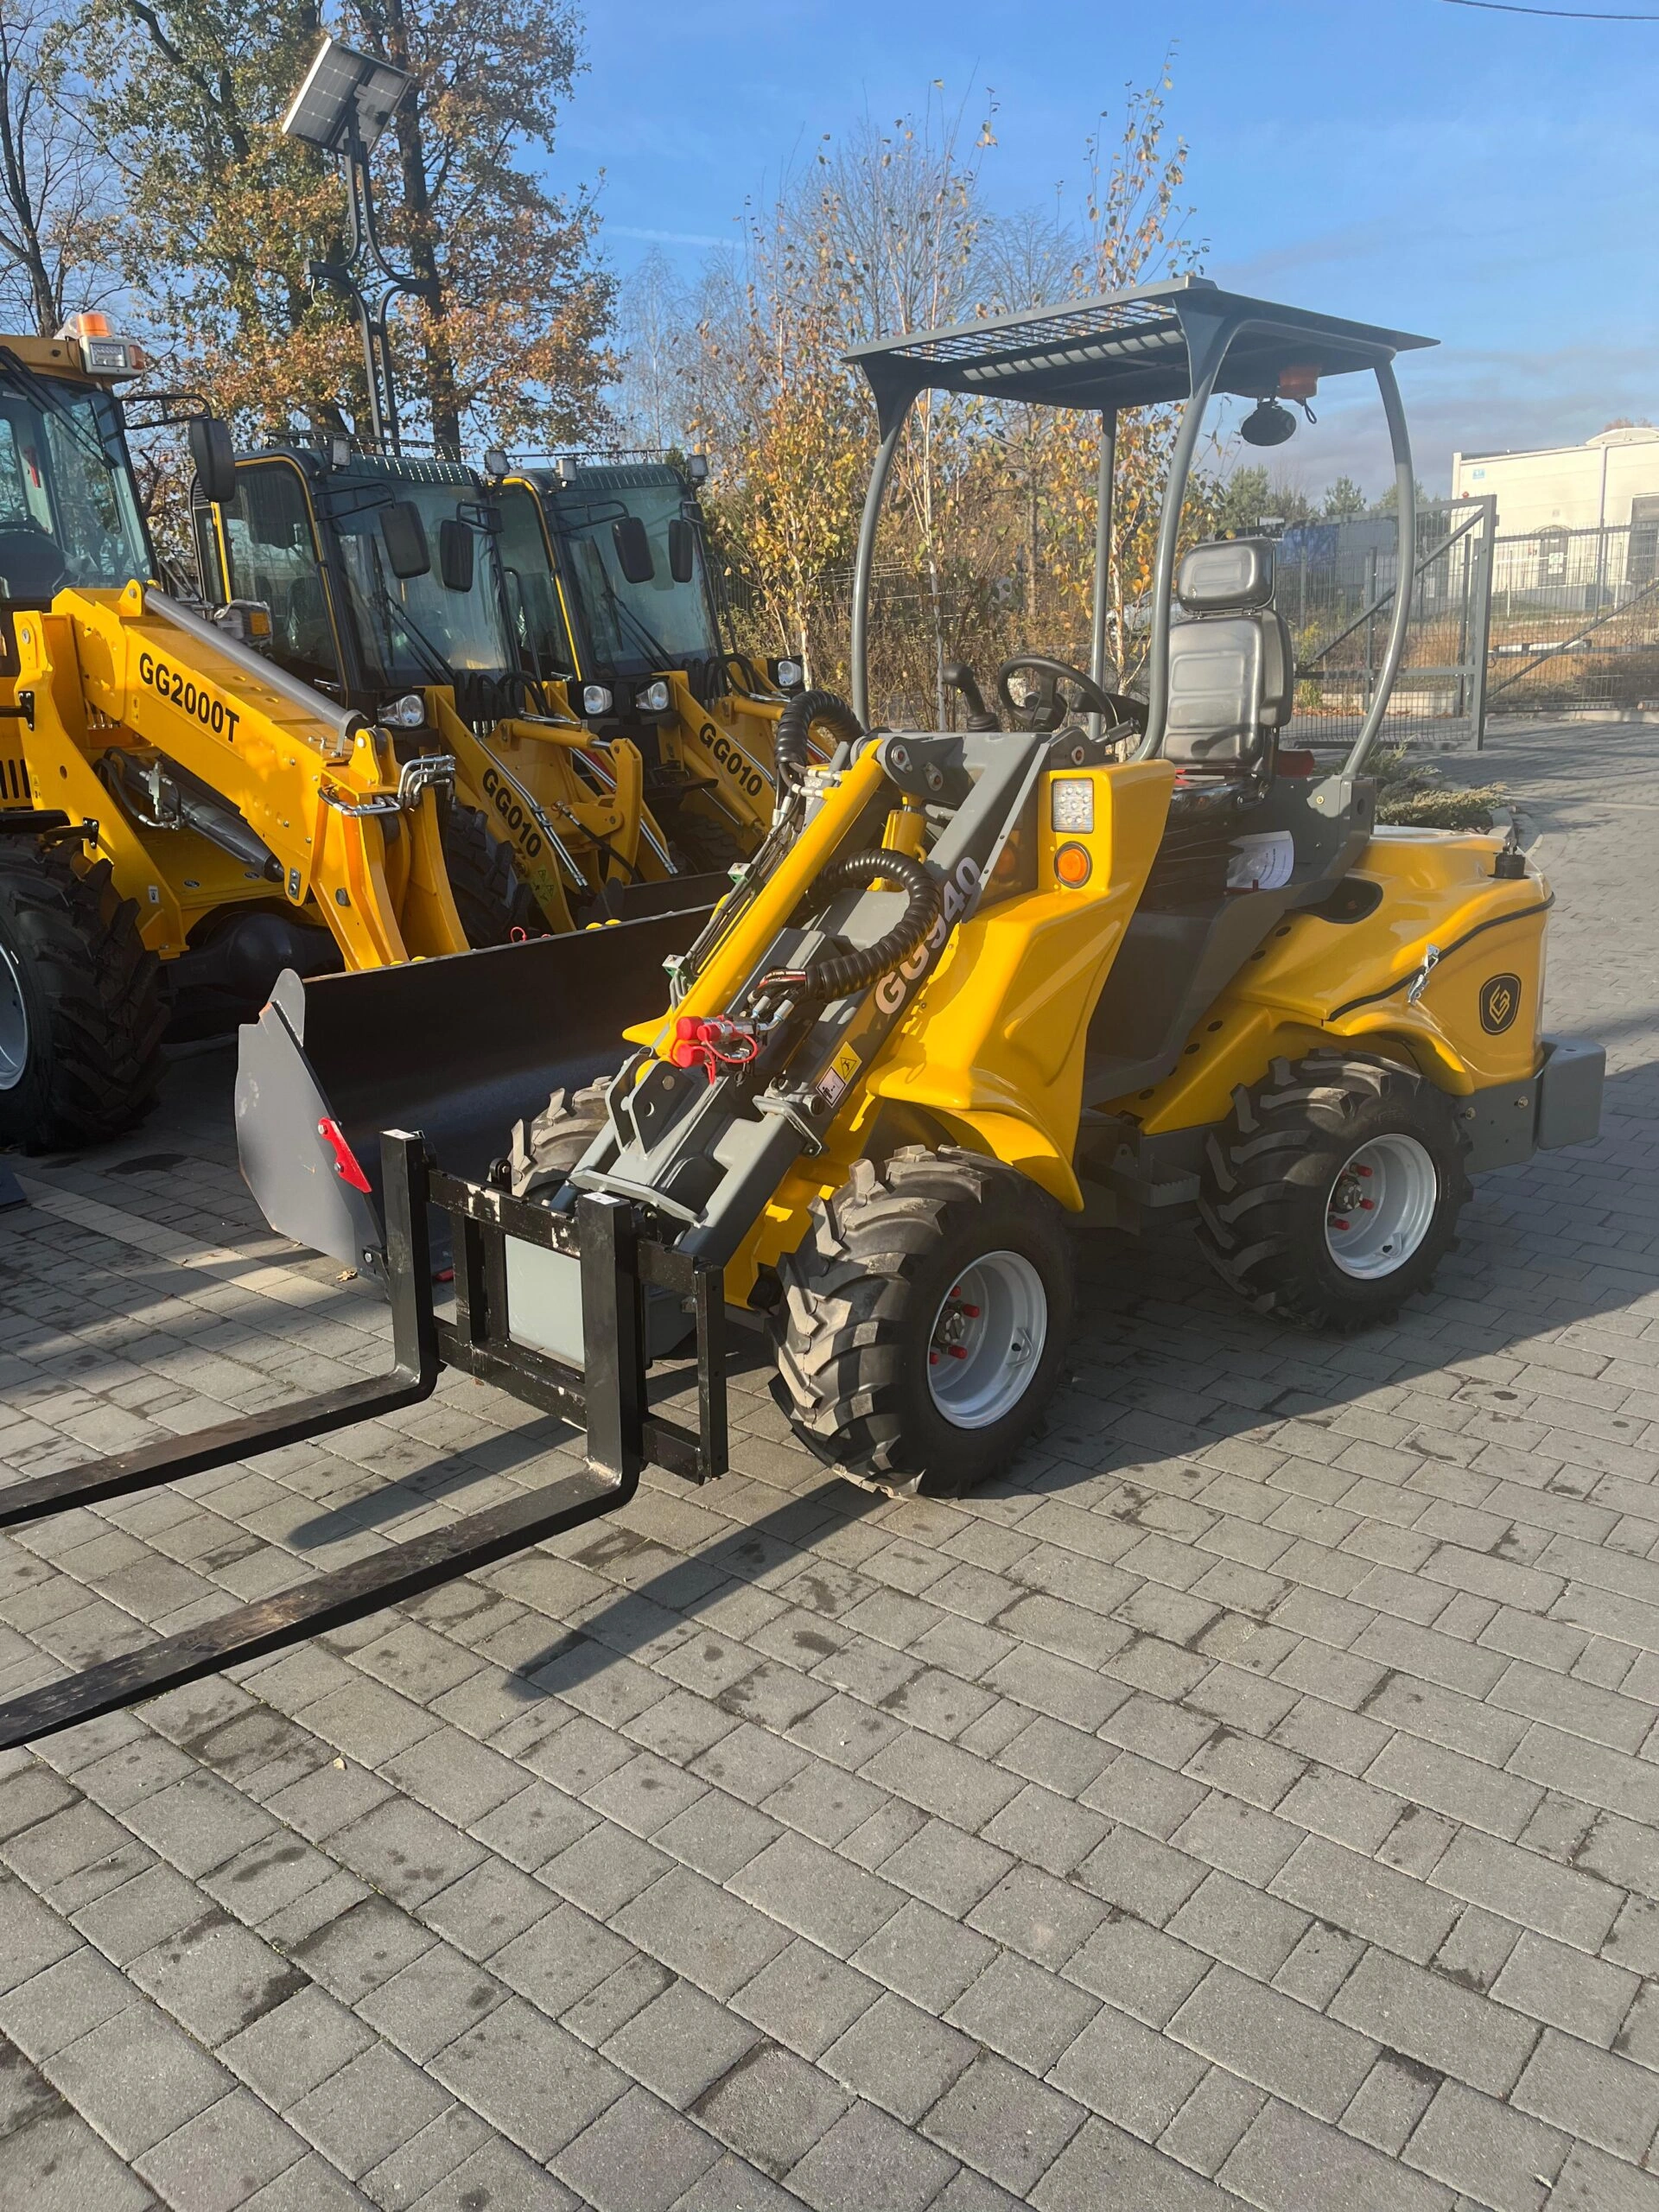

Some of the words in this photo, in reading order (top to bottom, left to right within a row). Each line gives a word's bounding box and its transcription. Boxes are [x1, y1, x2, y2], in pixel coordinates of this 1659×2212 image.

[140, 652, 240, 743] GG2000T
[700, 722, 762, 796] GG010
[483, 768, 542, 858] GG010
